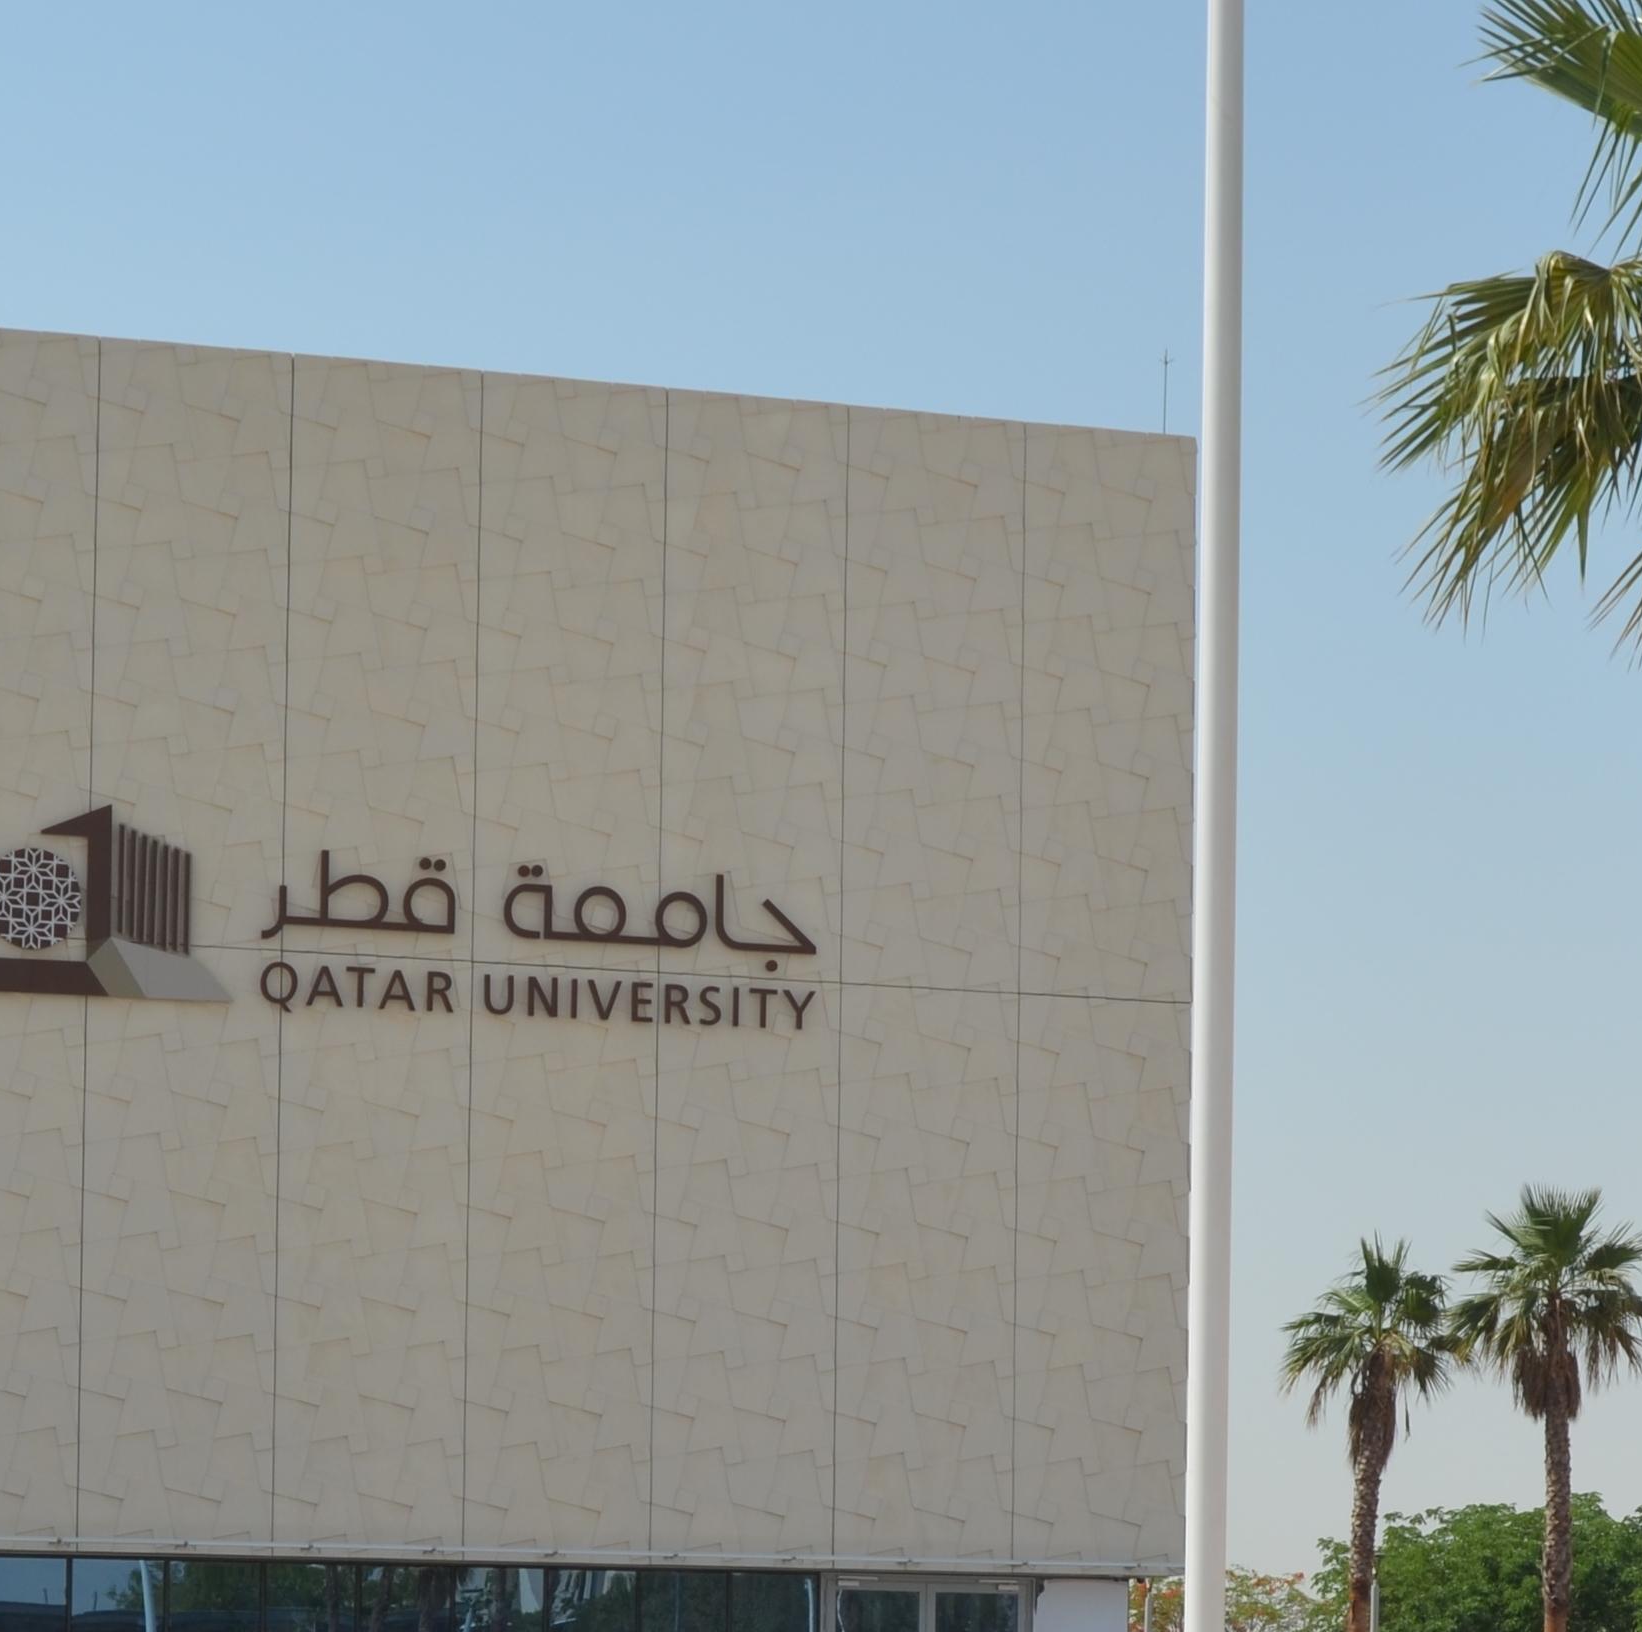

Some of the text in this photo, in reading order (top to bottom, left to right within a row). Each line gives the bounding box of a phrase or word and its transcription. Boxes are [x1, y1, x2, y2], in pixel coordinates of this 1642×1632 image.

[261, 849, 817, 973] جامعة قطر
[259, 961, 816, 1031] QATAR UNIVERSITY
